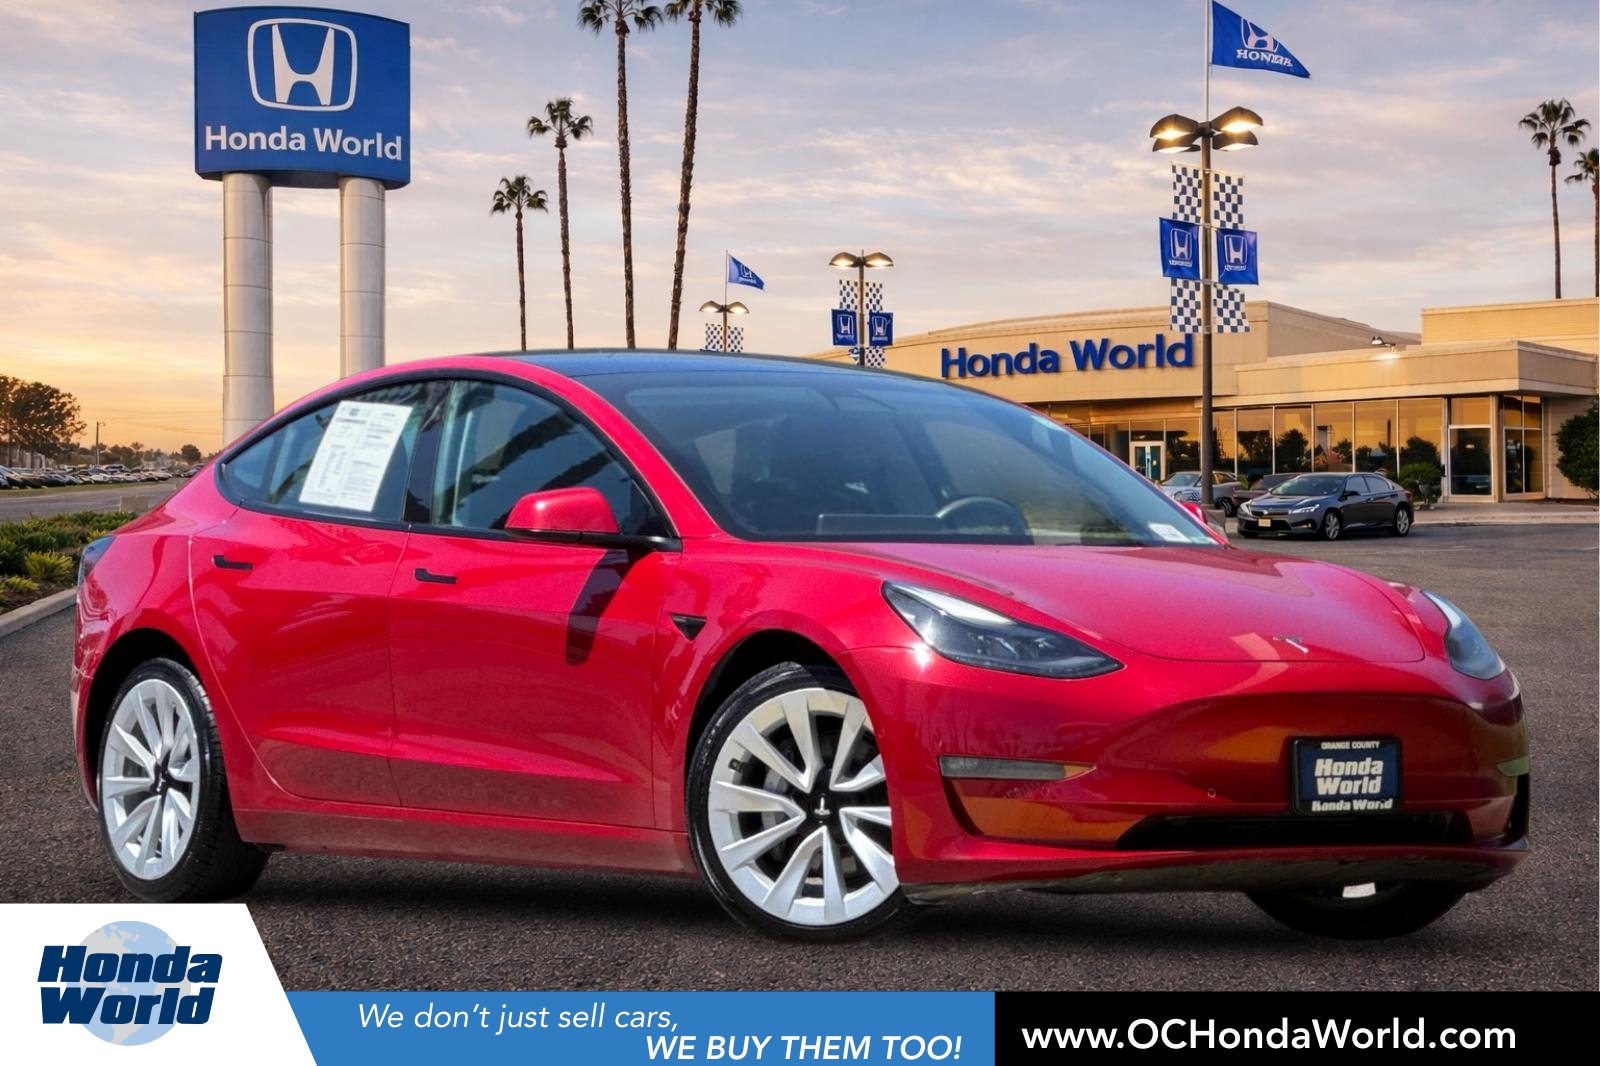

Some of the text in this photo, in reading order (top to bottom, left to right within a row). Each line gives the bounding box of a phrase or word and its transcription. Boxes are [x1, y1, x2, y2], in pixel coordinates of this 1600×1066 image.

[205, 125, 402, 160] Honda World
[941, 333, 1193, 378] Honda World
[1321, 740, 1380, 750] ORANGE COUNTY
[1314, 757, 1384, 777] Honda
[1316, 776, 1382, 795] World
[1352, 798, 1394, 810] Word
